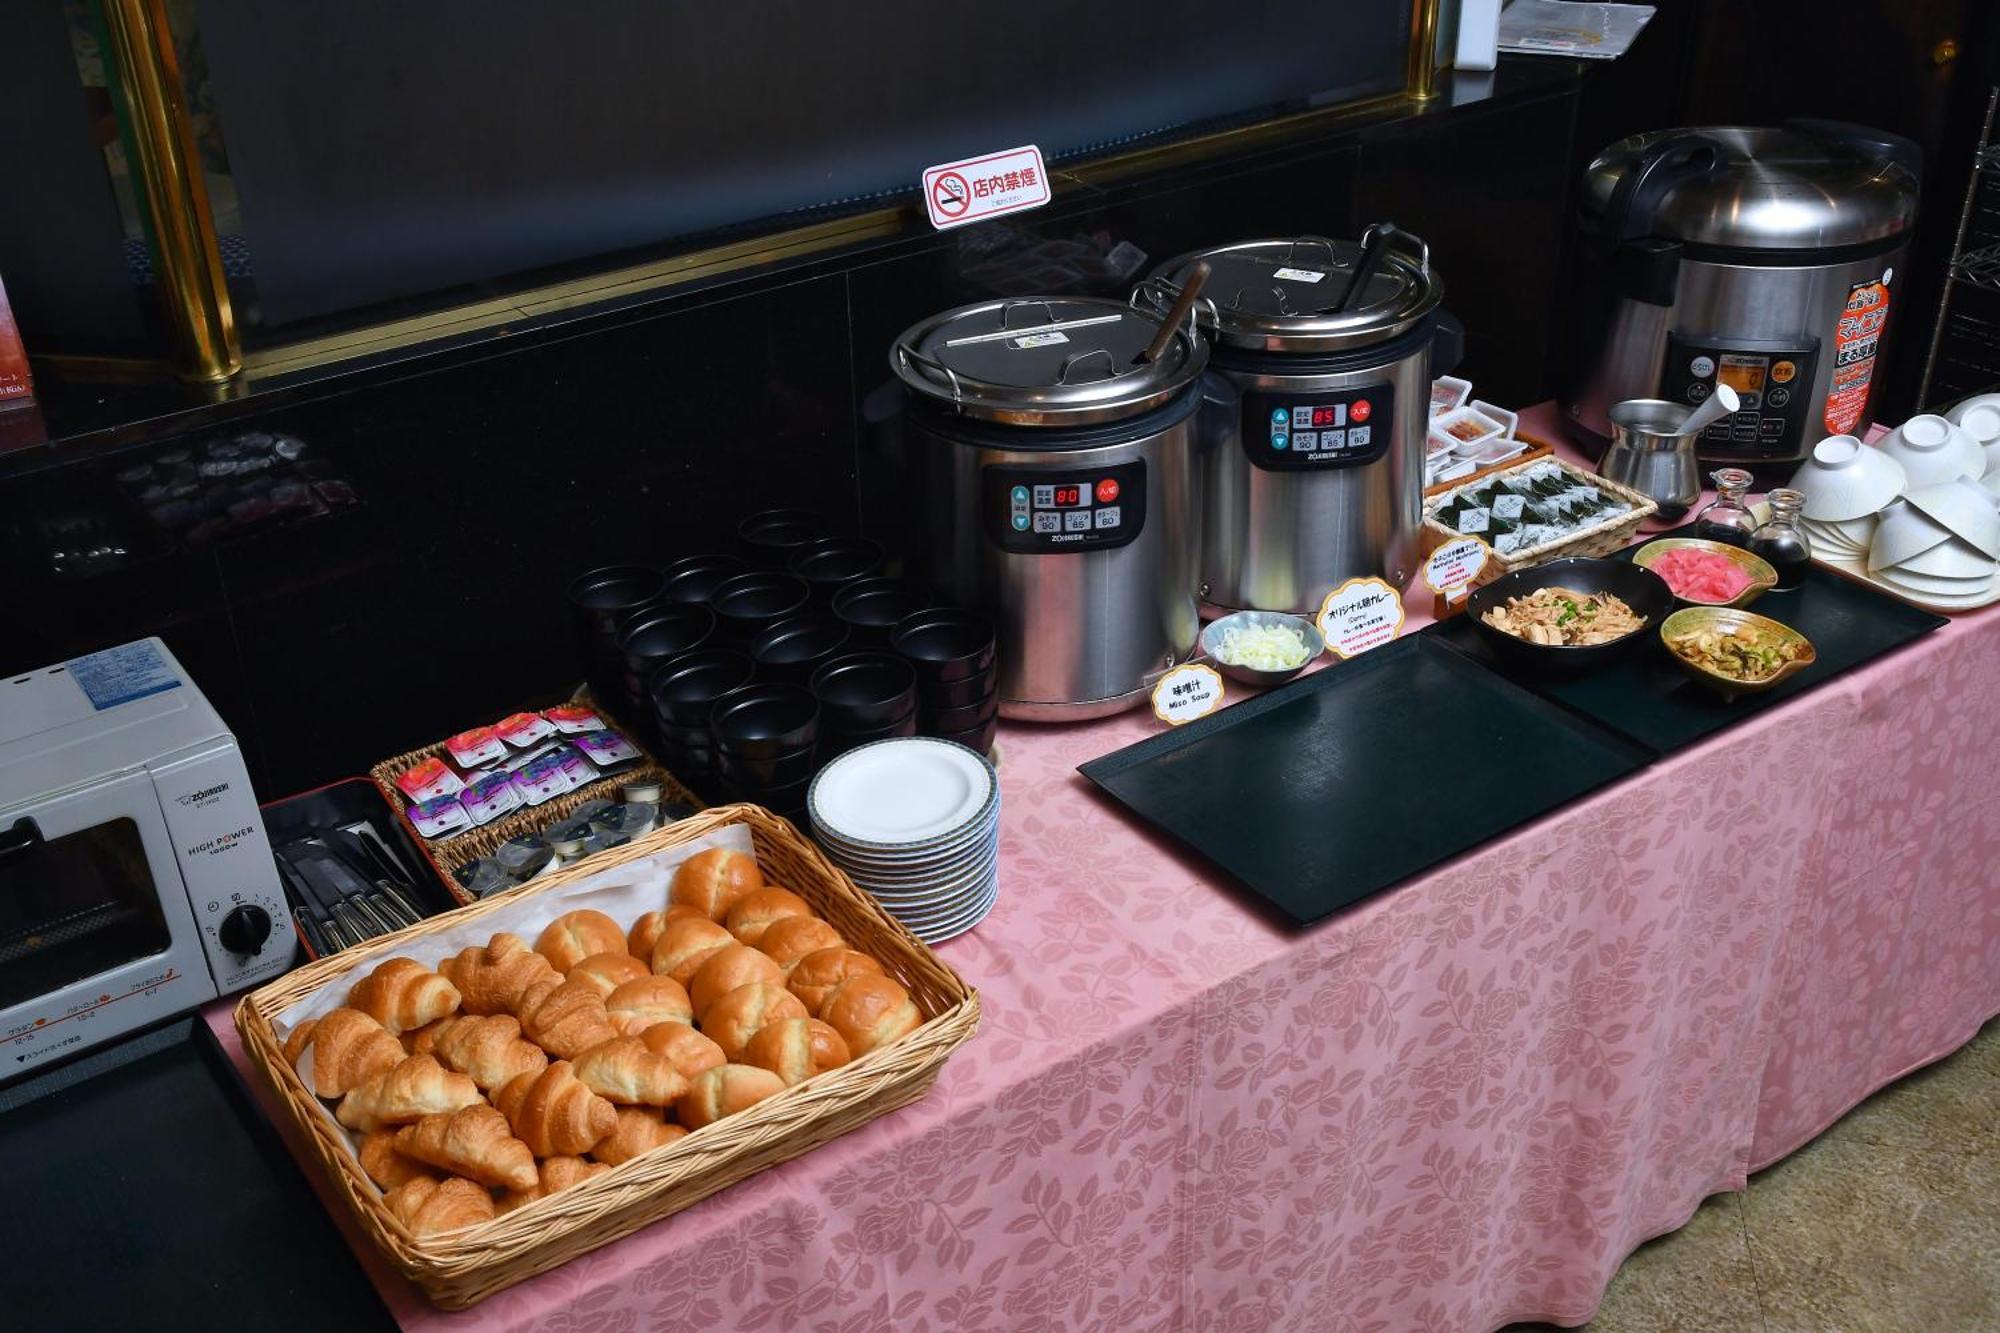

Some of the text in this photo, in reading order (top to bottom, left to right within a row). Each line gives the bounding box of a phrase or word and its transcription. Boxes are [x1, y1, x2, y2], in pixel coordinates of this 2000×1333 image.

[973, 168, 1038, 199] 店内禁煙
[1313, 410, 1334, 423] 85
[1041, 521, 1054, 530] 90
[1072, 521, 1085, 529] 85
[1328, 593, 1391, 620] オリジナル朝カレー
[1172, 679, 1201, 697] 味噌汁
[1168, 691, 1211, 709] Miso Soup
[188, 826, 254, 856] HIGH POWER
[209, 842, 238, 855] 1000W
